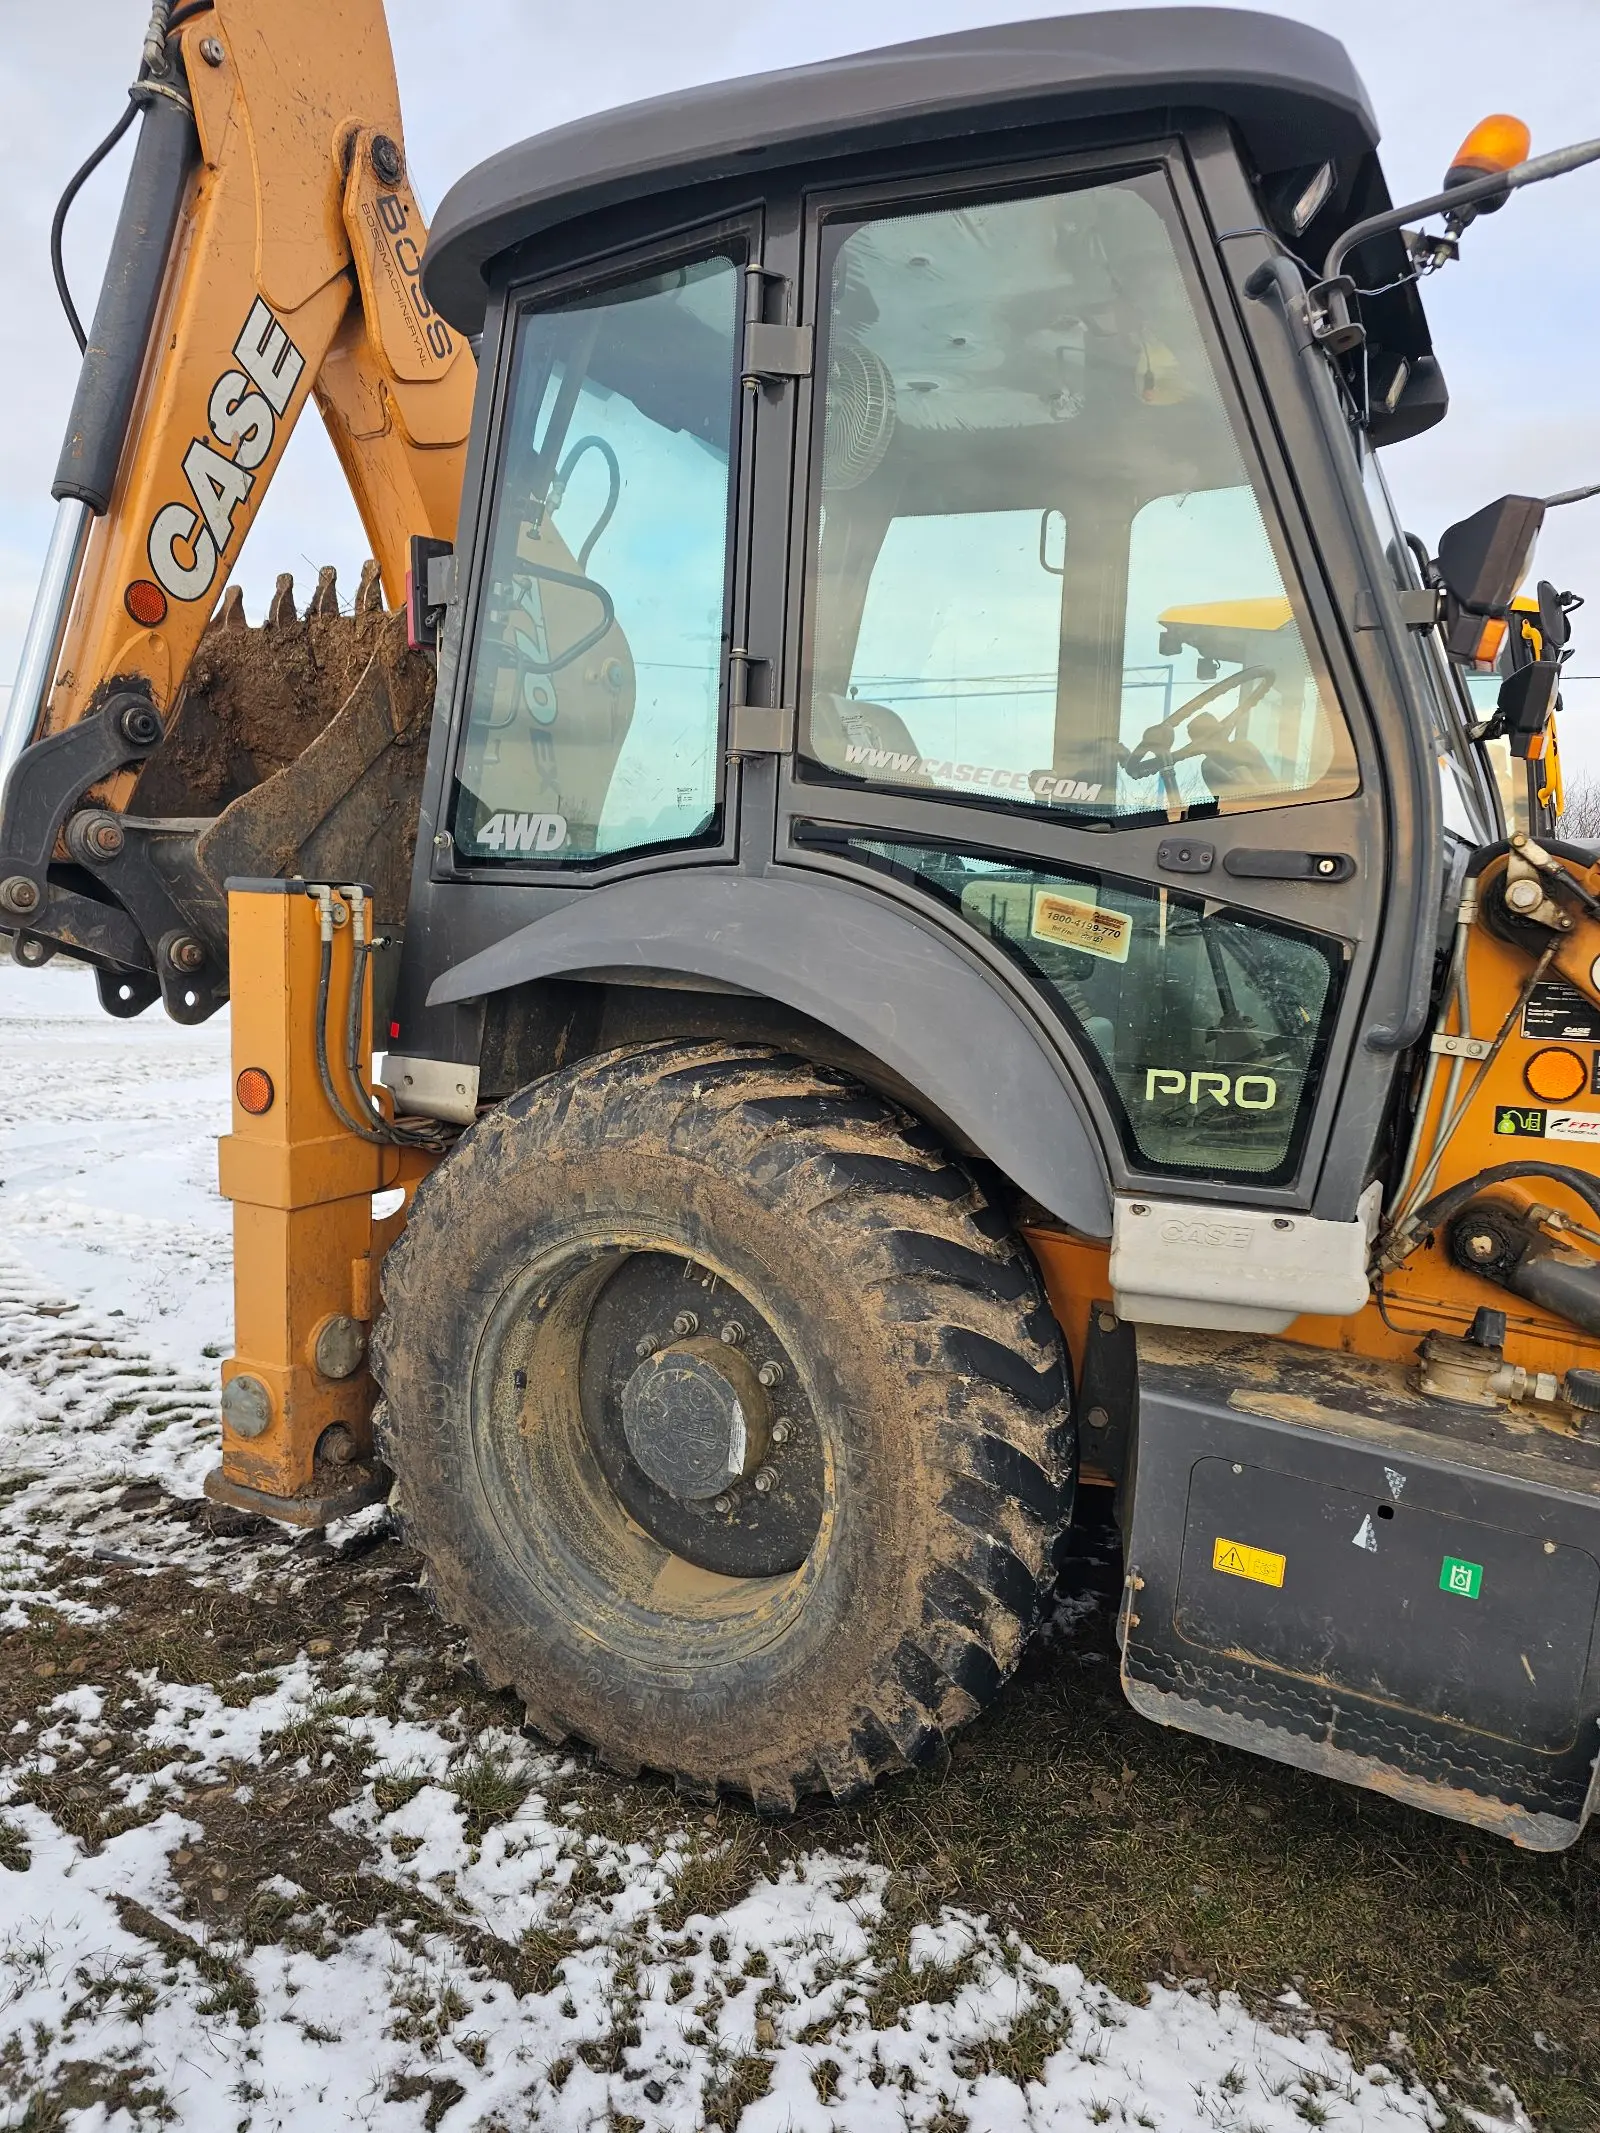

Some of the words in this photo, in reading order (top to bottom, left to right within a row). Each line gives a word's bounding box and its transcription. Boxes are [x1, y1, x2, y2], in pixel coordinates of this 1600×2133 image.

[147, 294, 306, 602] CASE
[845, 745, 1102, 802] WWW.CASECE.COM
[476, 813, 567, 851] 4WD
[1047, 911, 1121, 938] 1800-4199-770
[1146, 1068, 1277, 1110] PRO
[1568, 1121, 1600, 1130] FPT
[1160, 1219, 1255, 1249] CASE
